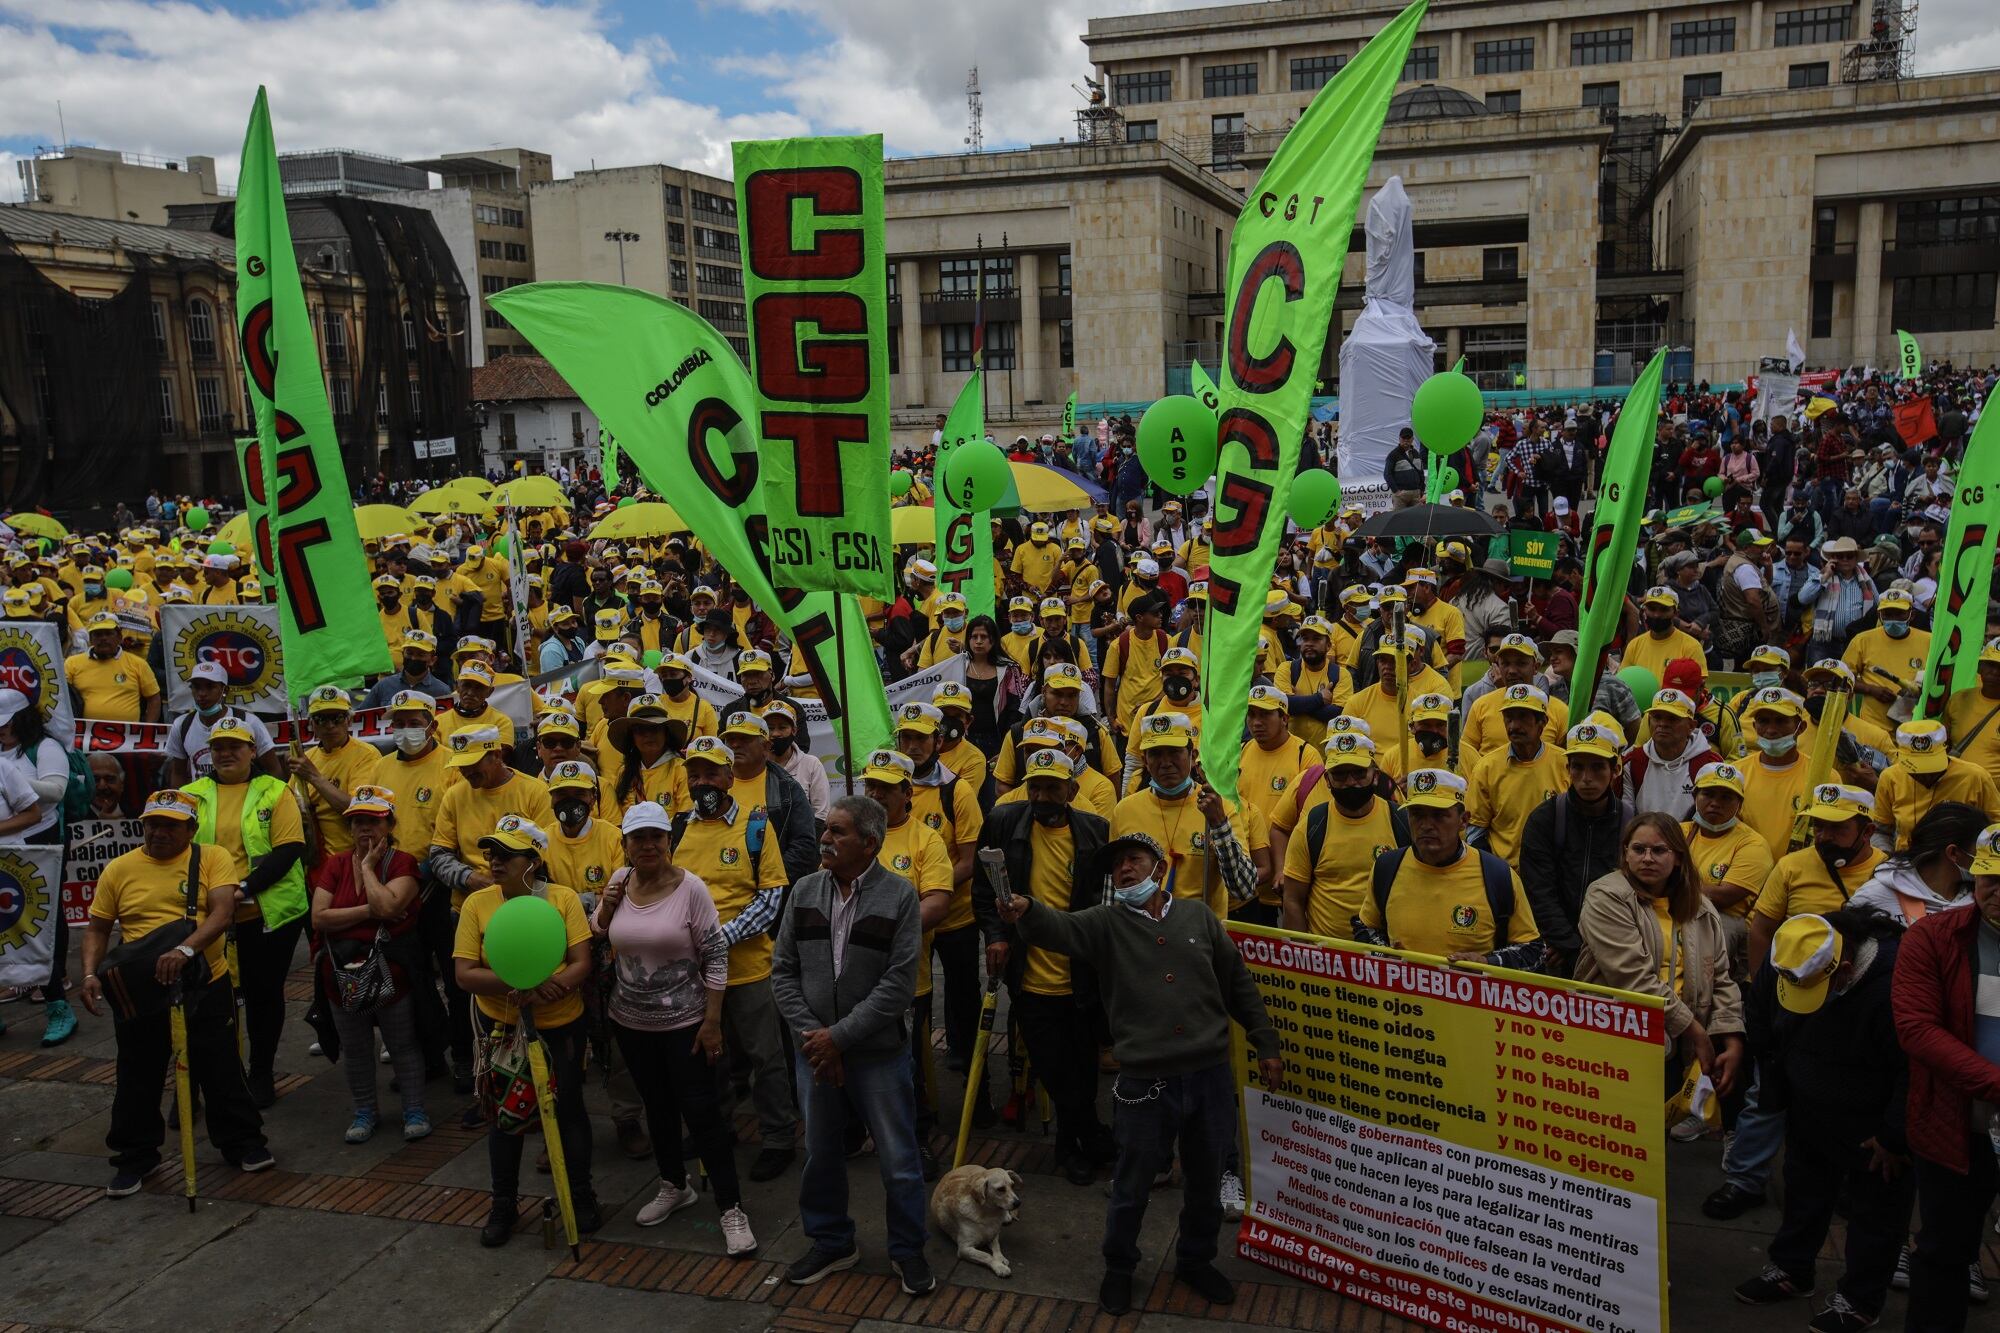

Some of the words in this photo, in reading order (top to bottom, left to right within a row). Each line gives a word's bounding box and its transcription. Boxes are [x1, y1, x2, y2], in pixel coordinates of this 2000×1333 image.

[1260, 191, 1324, 225] CGT
[745, 166, 870, 517] CGT
[1904, 344, 1915, 374] CGT
[645, 347, 713, 408] COLOMBIA
[1170, 427, 1186, 480] ADS
[964, 476, 974, 508] ADS
[1317, 499, 1336, 527] ADS
[772, 527, 813, 565] CSI
[833, 531, 883, 574] CSA
[1526, 541, 1544, 556] SOY
[197, 646, 260, 669] CTC
[899, 674, 942, 692] ESTADO
[483, 742, 495, 750] CGT
[1858, 804, 1870, 814] CGT
[1238, 938, 1347, 978] ¡COLOMBIA
[1350, 957, 1379, 985] UN
[1387, 964, 1474, 1002] PUEBLO
[1480, 980, 1649, 1038] MASOQUISTA!
[1248, 969, 1296, 991] ueblo
[1301, 976, 1330, 998] que
[1335, 987, 1378, 1009] tiene
[1383, 998, 1424, 1017] ojos
[1264, 993, 1298, 1012] eblo
[1302, 999, 1332, 1020] que
[1336, 1009, 1379, 1031] tiene
[1384, 1022, 1436, 1042] oidos
[1495, 1017, 1506, 1033] y
[1511, 1021, 1535, 1038] no
[1541, 1027, 1565, 1043] ve
[1303, 1023, 1333, 1044] que
[1338, 1030, 1379, 1052] tiene
[1384, 1041, 1447, 1068] lengua
[1304, 1044, 1335, 1063] que
[1339, 1052, 1380, 1075] tiene
[1385, 1064, 1444, 1089] mente
[1495, 1040, 1506, 1056] y
[1512, 1044, 1535, 1061] no
[1542, 1051, 1630, 1083] escucha
[1306, 1066, 1336, 1086] que
[1339, 1073, 1380, 1098] tiene
[1386, 1088, 1486, 1123] conciencia
[1496, 1063, 1506, 1080] y
[1513, 1067, 1536, 1085] no
[1542, 1072, 1600, 1100] habla
[1308, 1086, 1338, 1105] que
[1340, 1095, 1381, 1119] tiene
[1386, 1109, 1441, 1134] poder
[1497, 1087, 1507, 1103] y
[1513, 1091, 1537, 1109] no
[1543, 1098, 1636, 1134] recuerda
[1262, 1094, 1303, 1115] Pueblo
[1305, 1104, 1327, 1123] que
[1330, 1115, 1356, 1134] elige
[1359, 1124, 1443, 1156] gobernantes
[1446, 1148, 1471, 1165] con
[1475, 1155, 1546, 1184] promesas
[1550, 1176, 1558, 1190] y
[1562, 1178, 1632, 1210] mentiras
[1497, 1111, 1507, 1127] y
[1514, 1116, 1538, 1132] no
[1543, 1123, 1647, 1162] reacciona
[1498, 1134, 1509, 1150] y
[1514, 1139, 1538, 1156] no
[1544, 1144, 1562, 1162] lo
[1568, 1152, 1635, 1183] ejerce
[1261, 1129, 1332, 1164] Congresistas
[1335, 1156, 1357, 1173] que
[1360, 1163, 1400, 1185] hacen
[1404, 1174, 1440, 1195] leyes
[1442, 1186, 1472, 1206] para
[1477, 1195, 1540, 1224] legalizar
[1544, 1214, 1565, 1232] las
[1569, 1224, 1640, 1256] mentiras
[1292, 1119, 1348, 1150] Gobiernos
[1351, 1141, 1373, 1158] que
[1376, 1149, 1428, 1173] aplican
[1432, 1161, 1444, 1175] al
[1446, 1168, 1494, 1191] pueblo
[1498, 1182, 1523, 1199] sus
[1528, 1190, 1594, 1221] mentiras
[1272, 1151, 1308, 1175] Jueces
[1310, 1167, 1332, 1185] que
[1334, 1175, 1396, 1205] condenan
[1400, 1195, 1408, 1207] a
[1412, 1195, 1433, 1214] los
[1436, 1204, 1460, 1223] que
[1464, 1213, 1515, 1238] atacan
[1519, 1230, 1553, 1250] esas
[1557, 1242, 1625, 1274] mentiras
[1288, 1175, 1329, 1201] Medios
[1332, 1193, 1347, 1209] de
[1350, 1199, 1442, 1237] comunicación
[1445, 1228, 1470, 1248] que
[1474, 1235, 1528, 1263] falsean
[1533, 1252, 1546, 1269] la
[1551, 1260, 1602, 1288] verdad
[1255, 1200, 1268, 1215] El
[1268, 1206, 1312, 1233] sistema
[1315, 1224, 1374, 1257] financiero
[1376, 1248, 1419, 1270] dueño
[1423, 1262, 1440, 1276] de
[1443, 1268, 1474, 1289] todo
[1476, 1280, 1485, 1293] y
[1488, 1284, 1583, 1322] esclavizador
[1586, 1314, 1605, 1331] de
[1277, 1190, 1340, 1225] Periodistas
[1342, 1216, 1365, 1235] que
[1367, 1227, 1390, 1243] son
[1395, 1233, 1416, 1249] los
[1419, 1240, 1488, 1273] complices
[1491, 1263, 1510, 1278] de
[1514, 1272, 1549, 1291] esas
[1553, 1283, 1621, 1316] mentiras
[1240, 1241, 1328, 1285] desnutrido
[1332, 1275, 1341, 1291] y
[1346, 1281, 1441, 1325] arrastrado
[1249, 1222, 1268, 1242] Lo
[1271, 1231, 1304, 1256] más
[1308, 1246, 1355, 1276] Grave
[1359, 1268, 1381, 1283] es
[1386, 1276, 1422, 1300] que
[1426, 1288, 1466, 1312] este
[1471, 1302, 1539, 1333] pueblo
